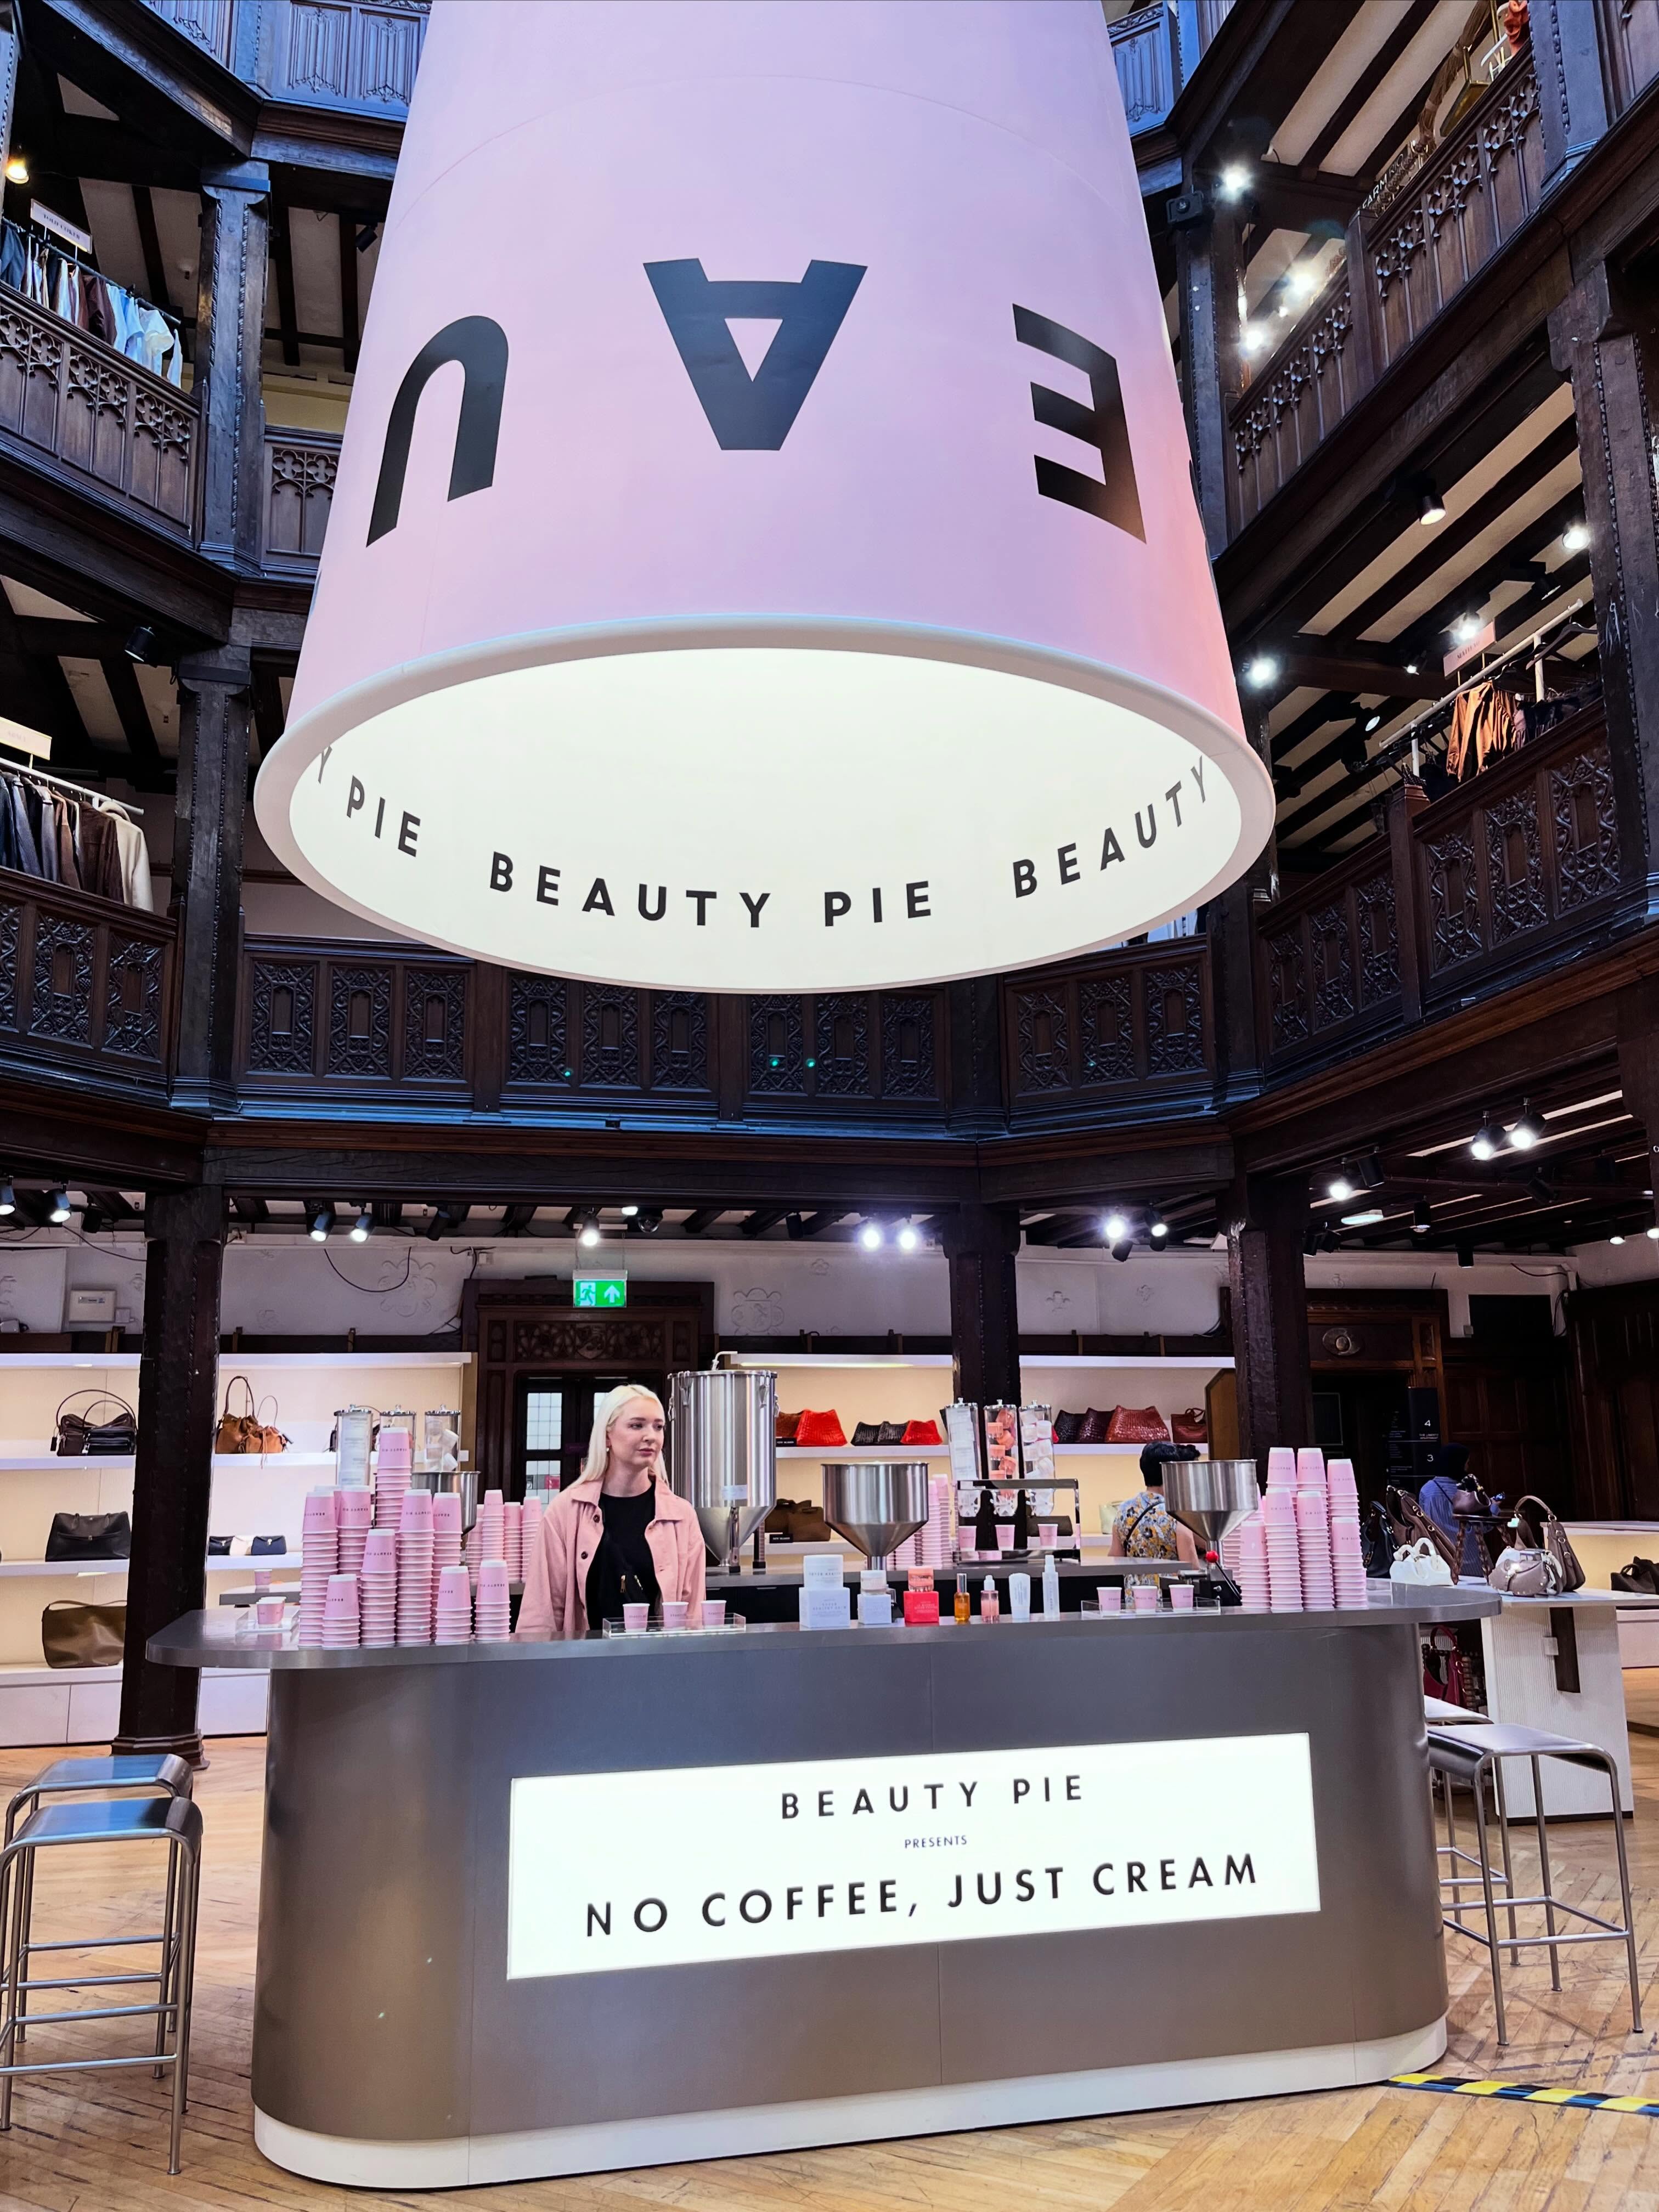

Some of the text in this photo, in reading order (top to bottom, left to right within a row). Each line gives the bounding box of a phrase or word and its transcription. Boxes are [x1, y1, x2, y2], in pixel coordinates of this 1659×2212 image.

[346, 775, 421, 857] PIE
[489, 851, 771, 928] BEAUTY
[824, 881, 931, 927] PIE
[1012, 755, 1206, 899] BEAUTY
[782, 1775, 1081, 1819] BEAUTY PIE
[904, 1836, 967, 1848] PRESENTS
[587, 1854, 1256, 1937] NO COFFEE, JUST CREAM
